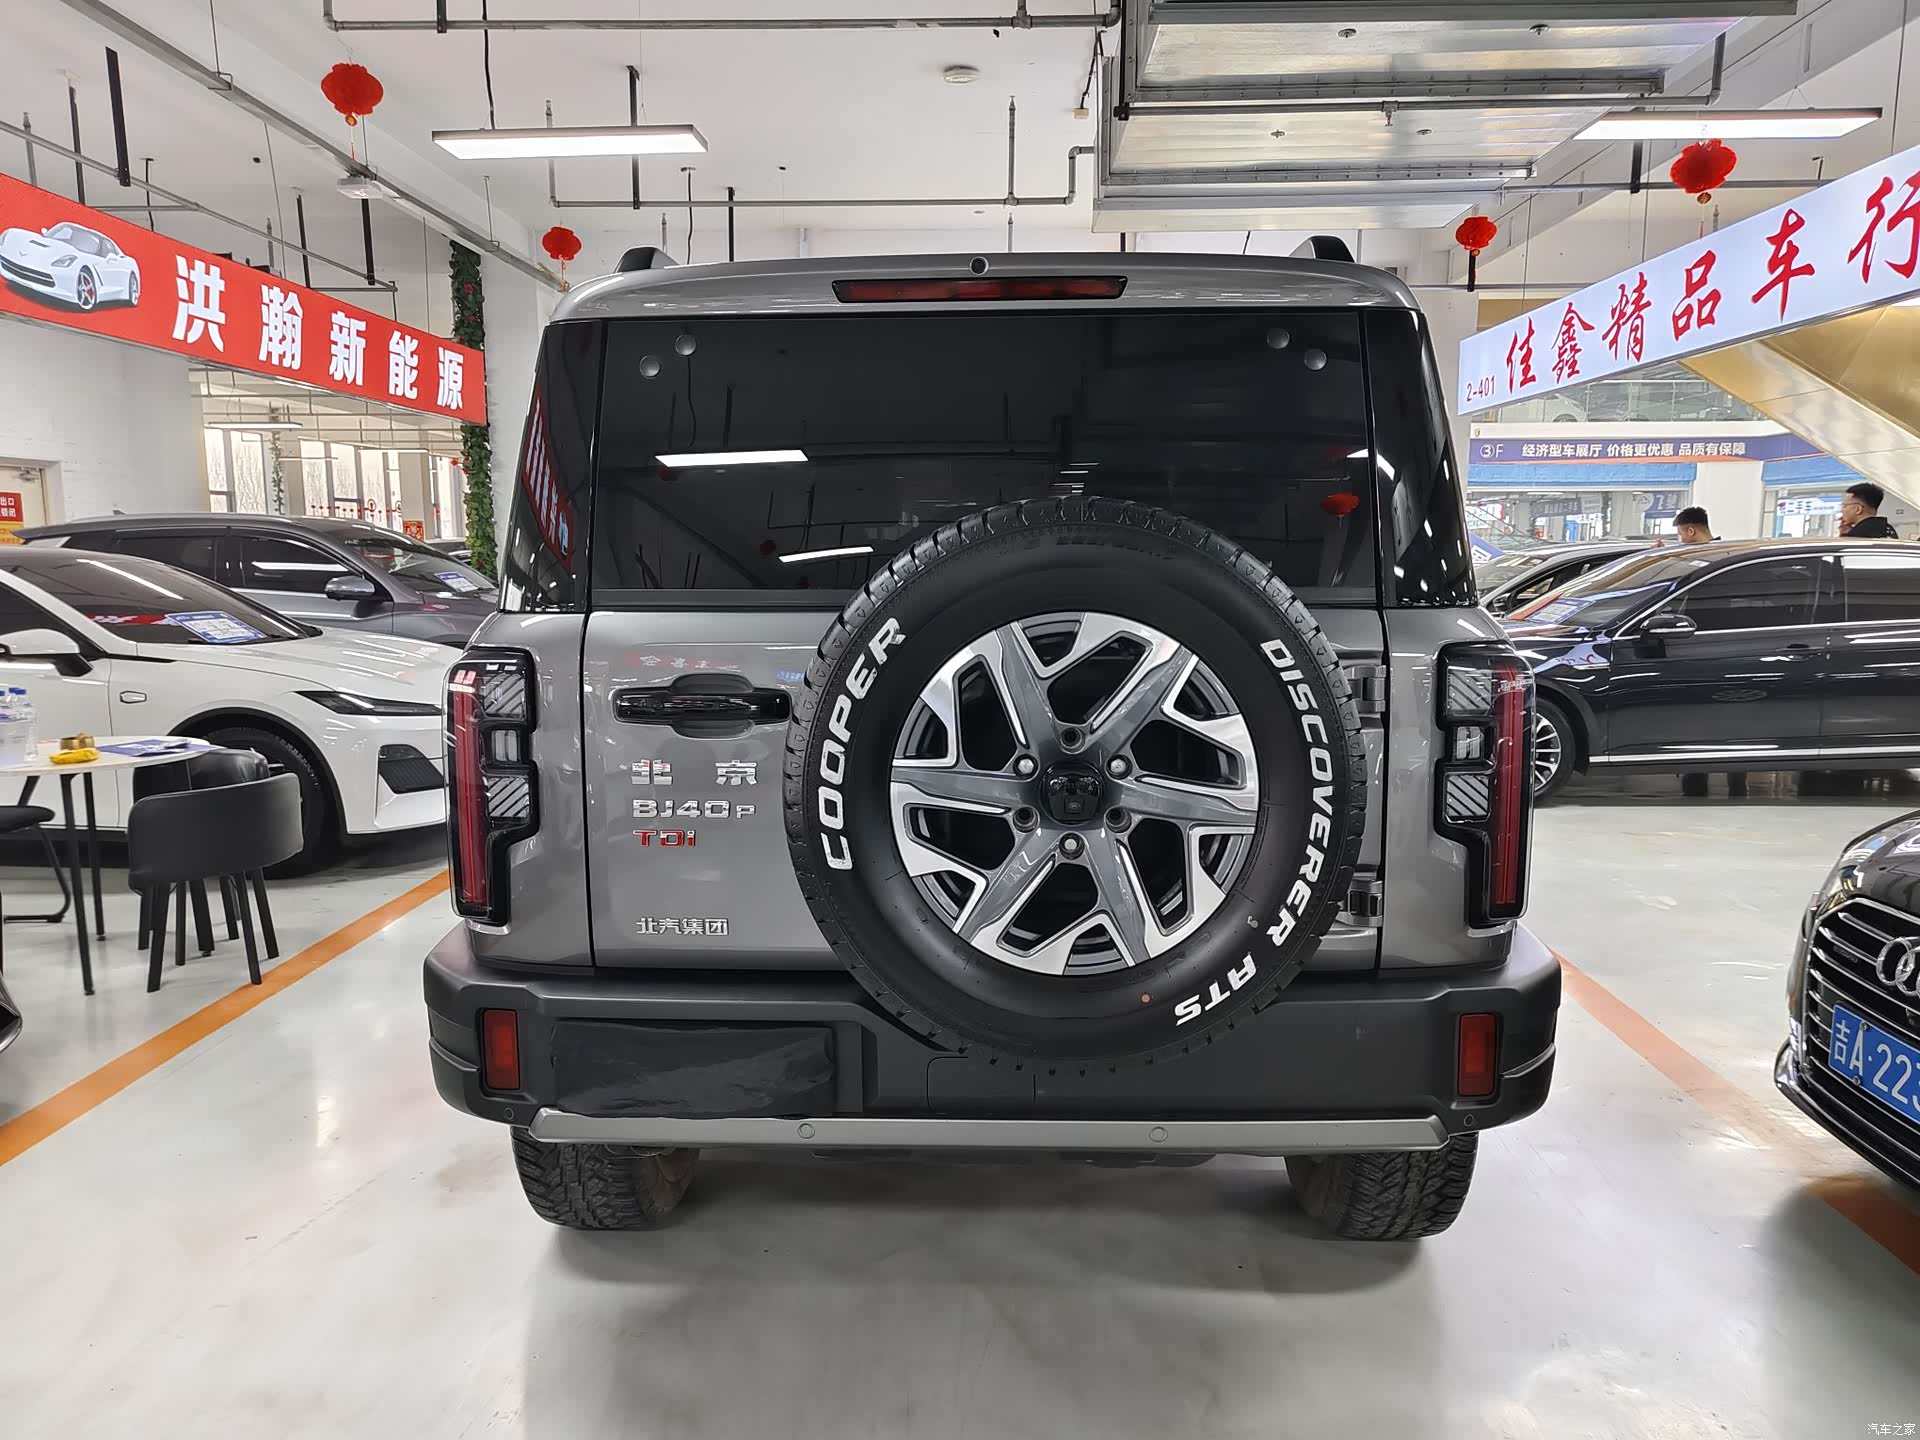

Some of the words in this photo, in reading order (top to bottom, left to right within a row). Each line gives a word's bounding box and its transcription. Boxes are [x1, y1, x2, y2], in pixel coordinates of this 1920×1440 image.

[172, 255, 464, 410] 洪瀚新能源
[1505, 171, 1920, 395] 佳鑫精品车行
[1466, 375, 1495, 402] 2-401
[1521, 443, 1603, 458] 经济型车展厅
[1606, 442, 1674, 457] 价格更优惠
[1678, 441, 1746, 456] 品质有保障
[818, 617, 906, 870] COOPER
[1260, 638, 1334, 946] DISCOVERER
[636, 916, 730, 936] 北汽集团
[1175, 953, 1257, 1027] ATS
